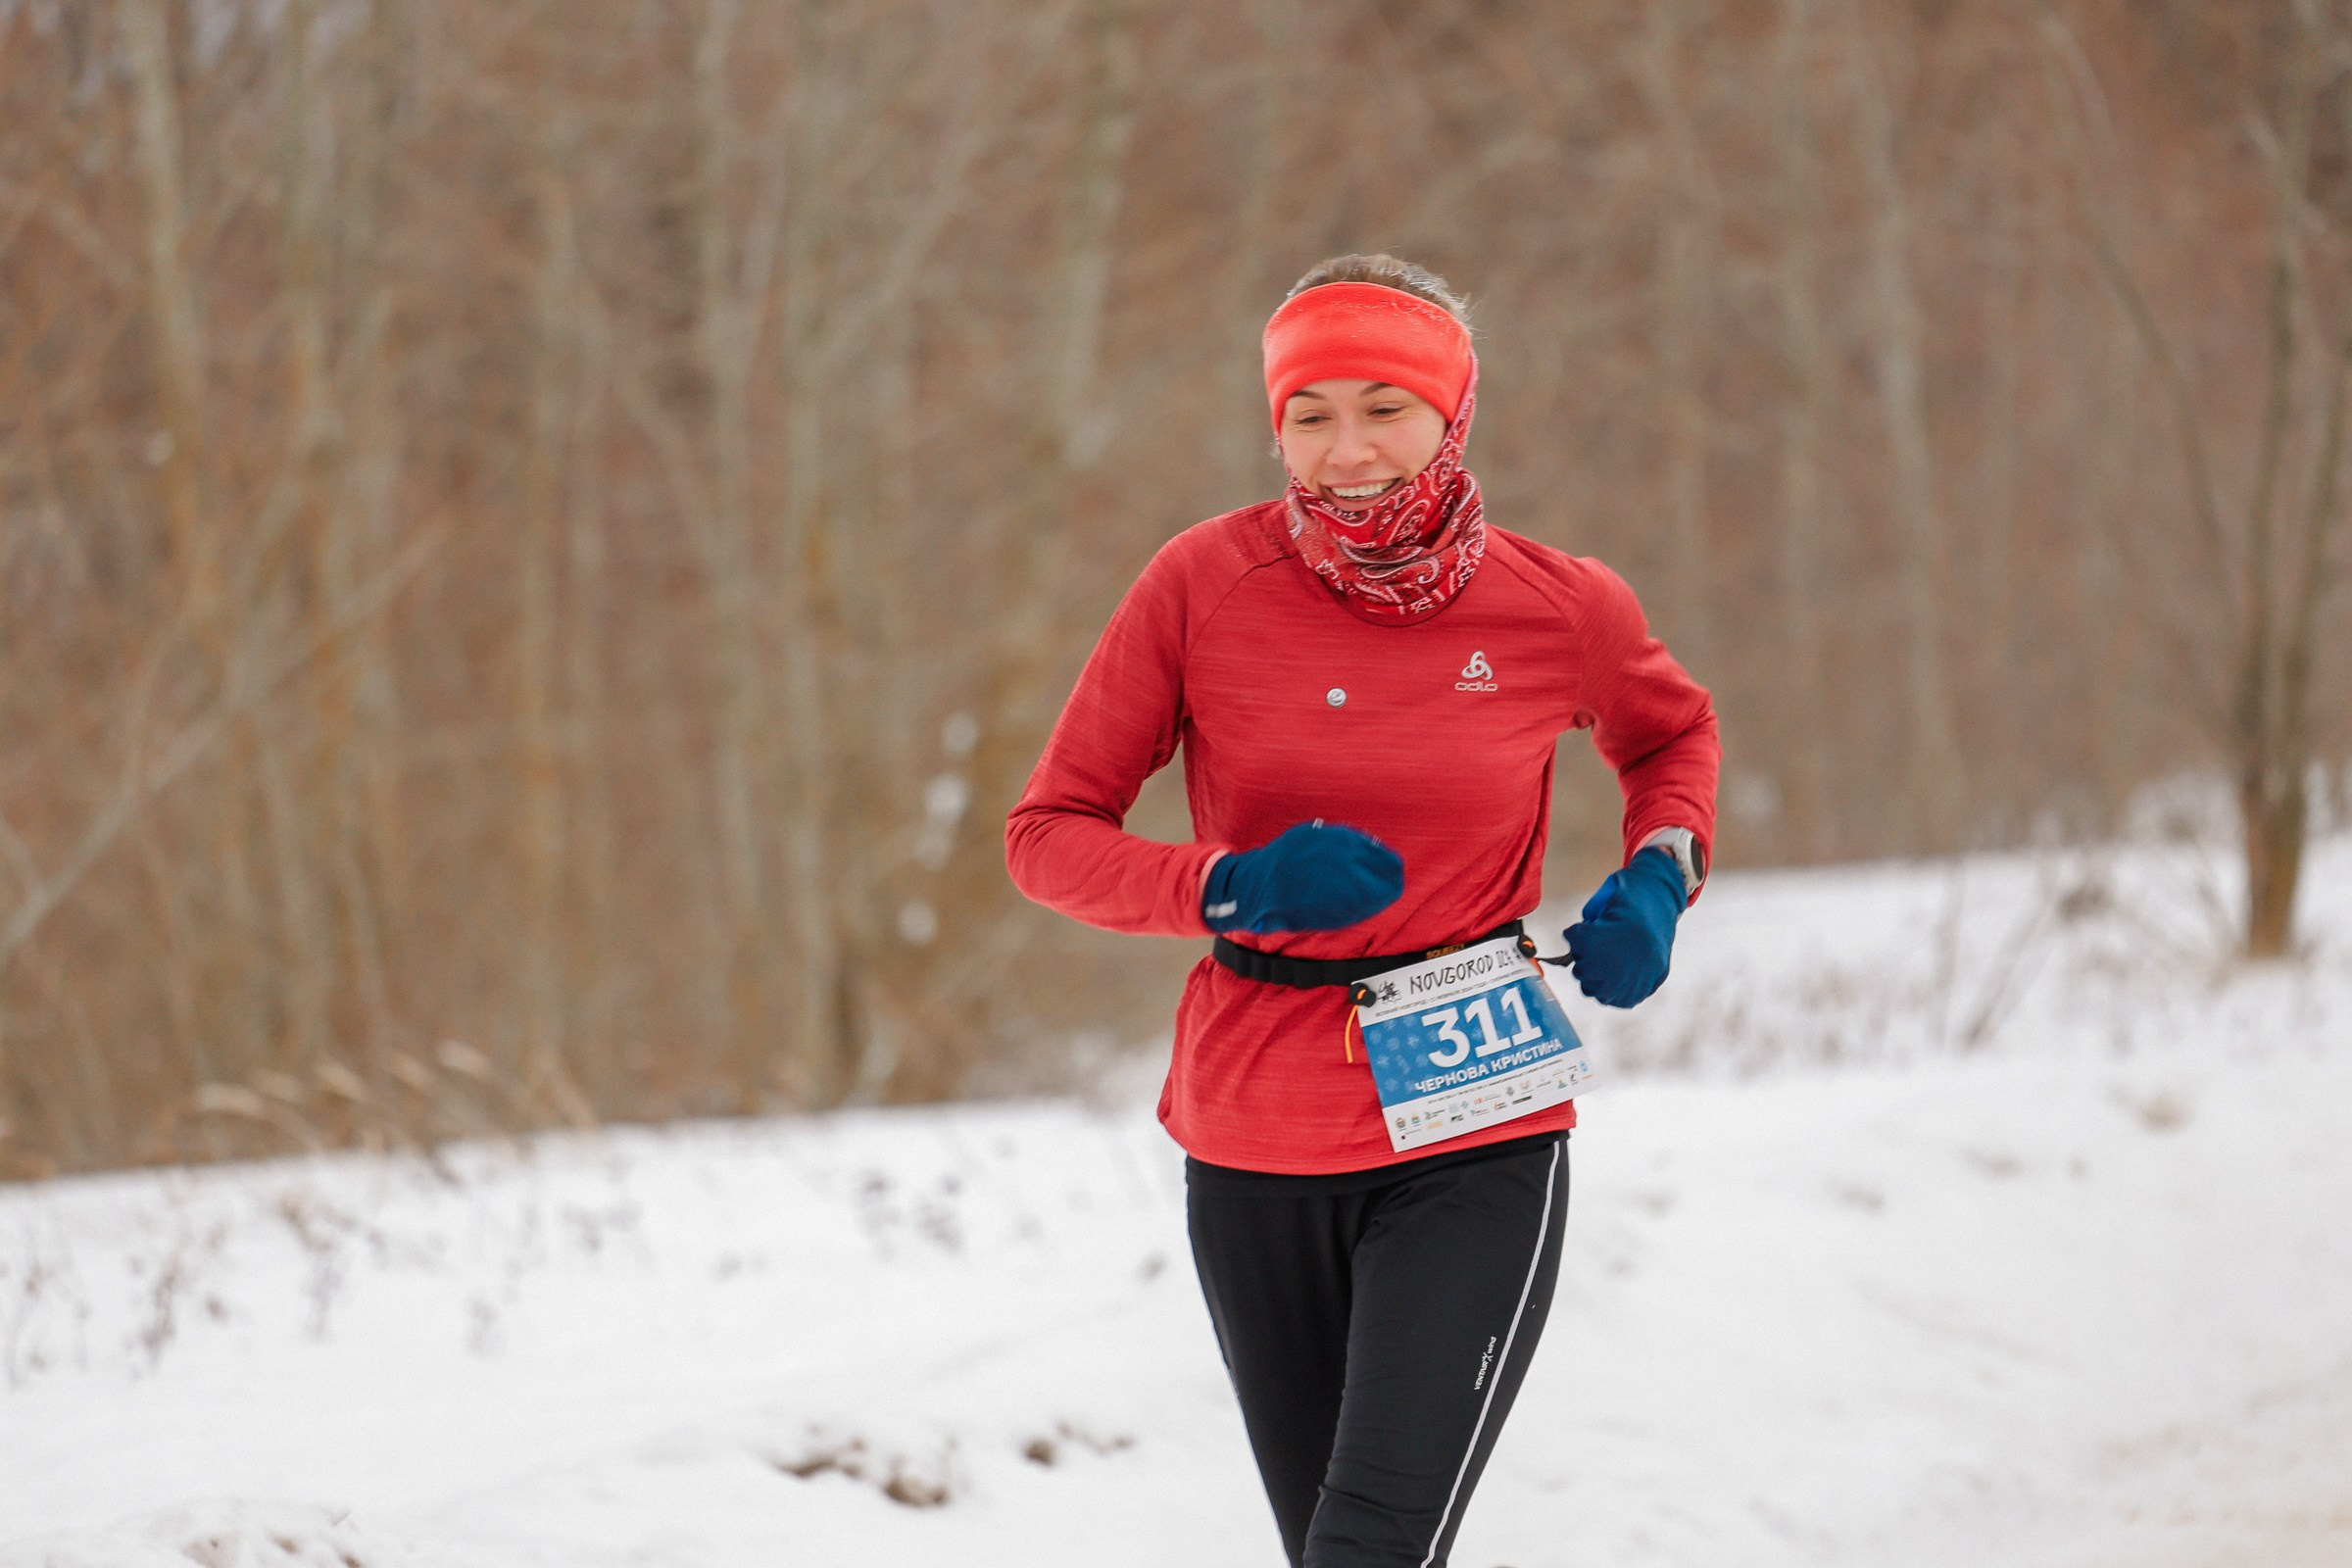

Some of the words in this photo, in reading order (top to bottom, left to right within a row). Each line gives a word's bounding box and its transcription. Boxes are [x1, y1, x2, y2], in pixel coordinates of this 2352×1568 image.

[1410, 955, 1493, 994] NOVGOROD
[1421, 987, 1543, 1068] 311
[1415, 1061, 1490, 1093] ЧЕРНОВА
[1492, 1038, 1562, 1071] КРИСТИНА
